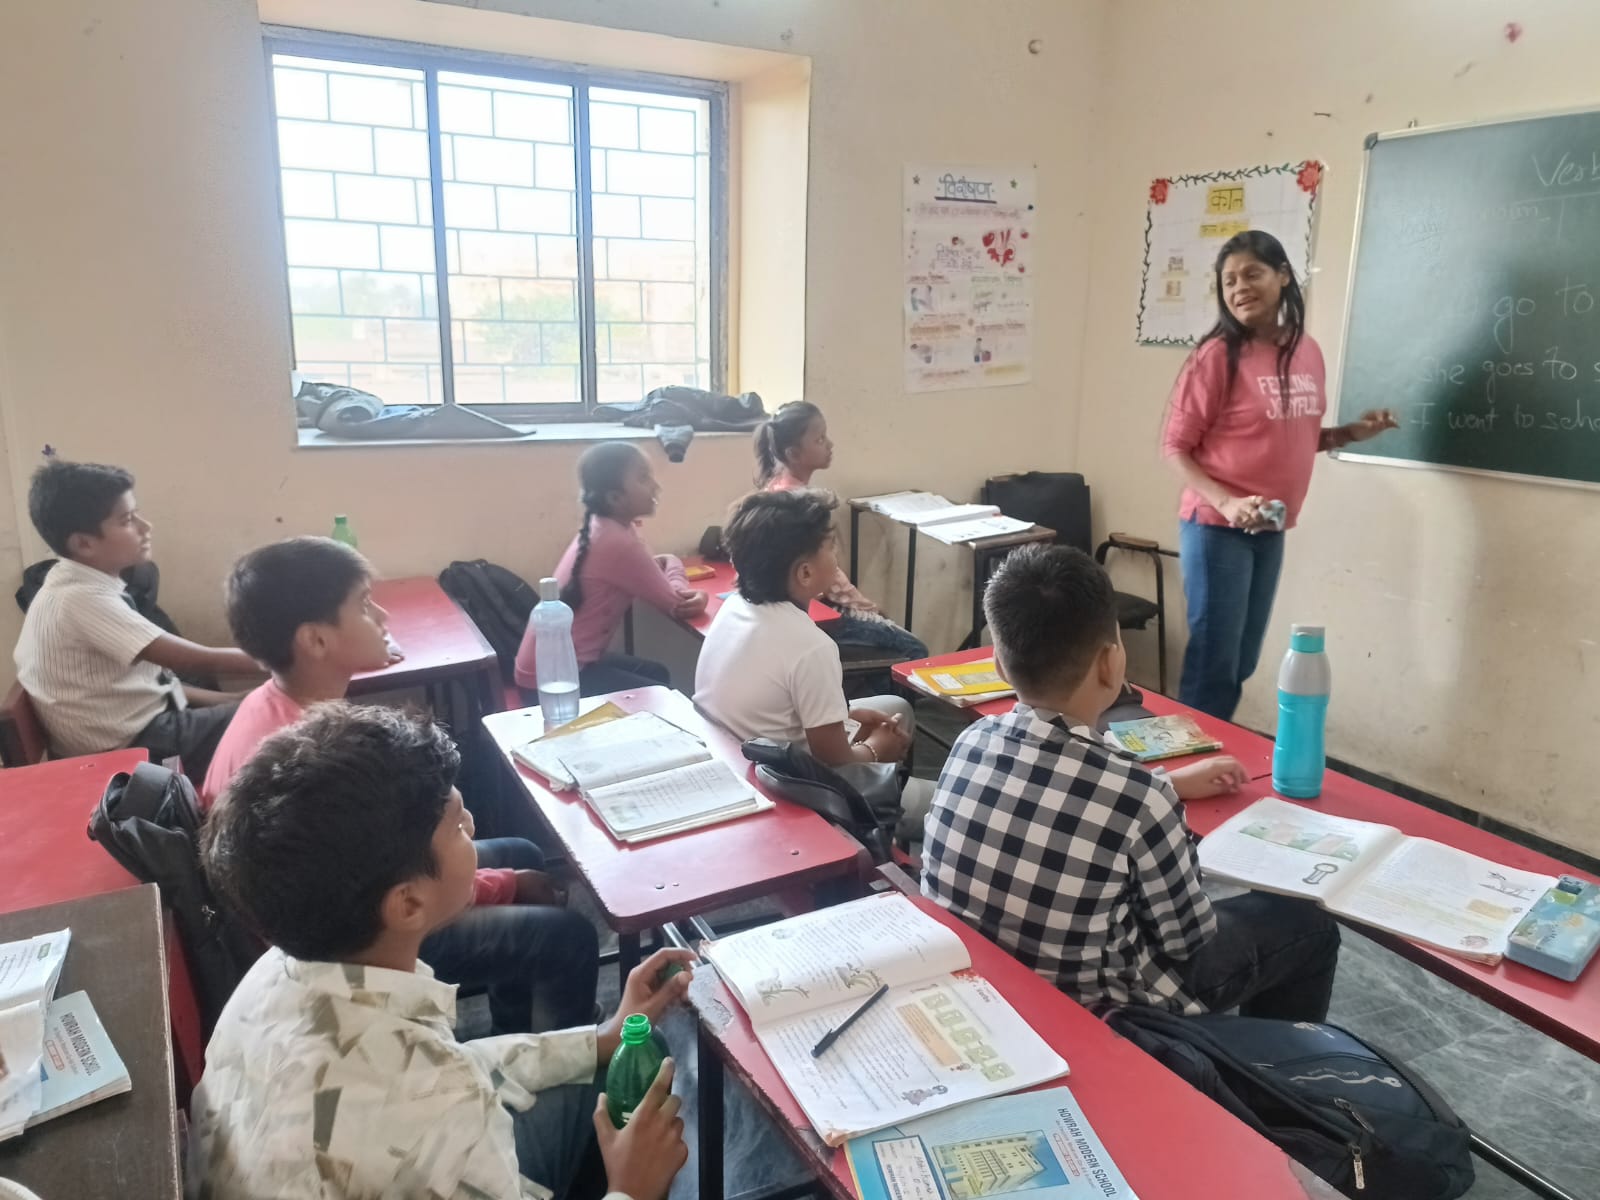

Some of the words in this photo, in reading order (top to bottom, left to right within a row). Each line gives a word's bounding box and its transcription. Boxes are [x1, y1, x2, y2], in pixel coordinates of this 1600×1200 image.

[1492, 295, 1536, 354] go
[1554, 274, 1595, 316] to
[1257, 373, 1318, 396] FELING
[1482, 360, 1535, 404] goes
[1057, 1107, 1082, 1137] HOWRAH
[1074, 1137, 1101, 1169] MODERN
[1092, 1168, 1117, 1198] SCHOOL
